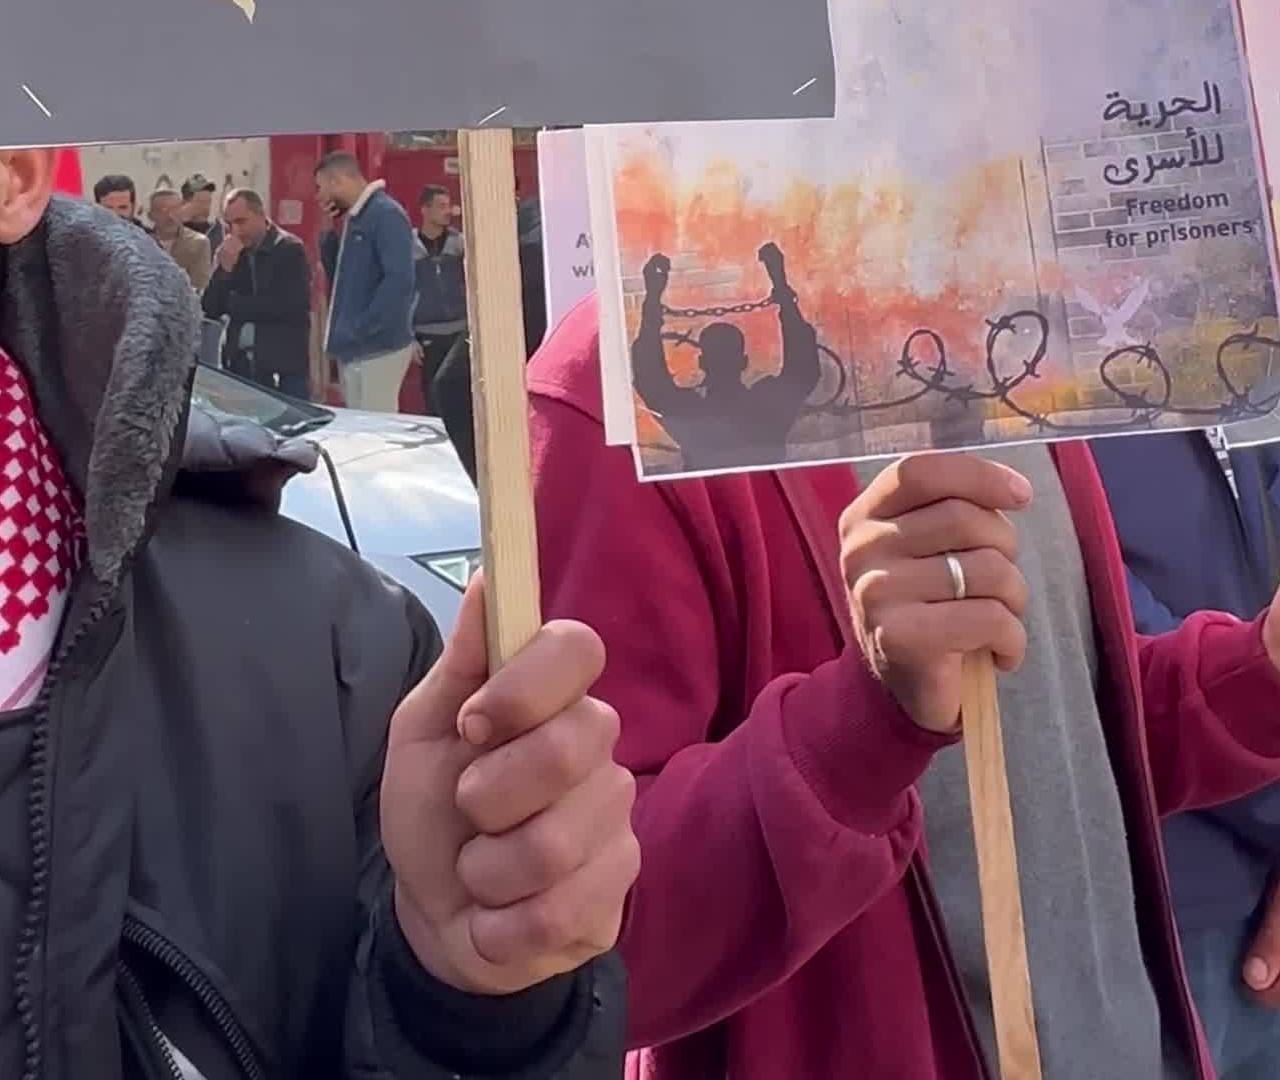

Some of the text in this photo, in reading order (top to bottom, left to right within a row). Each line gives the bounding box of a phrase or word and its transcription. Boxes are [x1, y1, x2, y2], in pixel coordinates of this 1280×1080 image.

[1103, 80, 1221, 128] الحرية
[1103, 127, 1224, 185] للأسرى
[1126, 192, 1229, 217] Freedom
[1105, 219, 1253, 249] for prisoners
